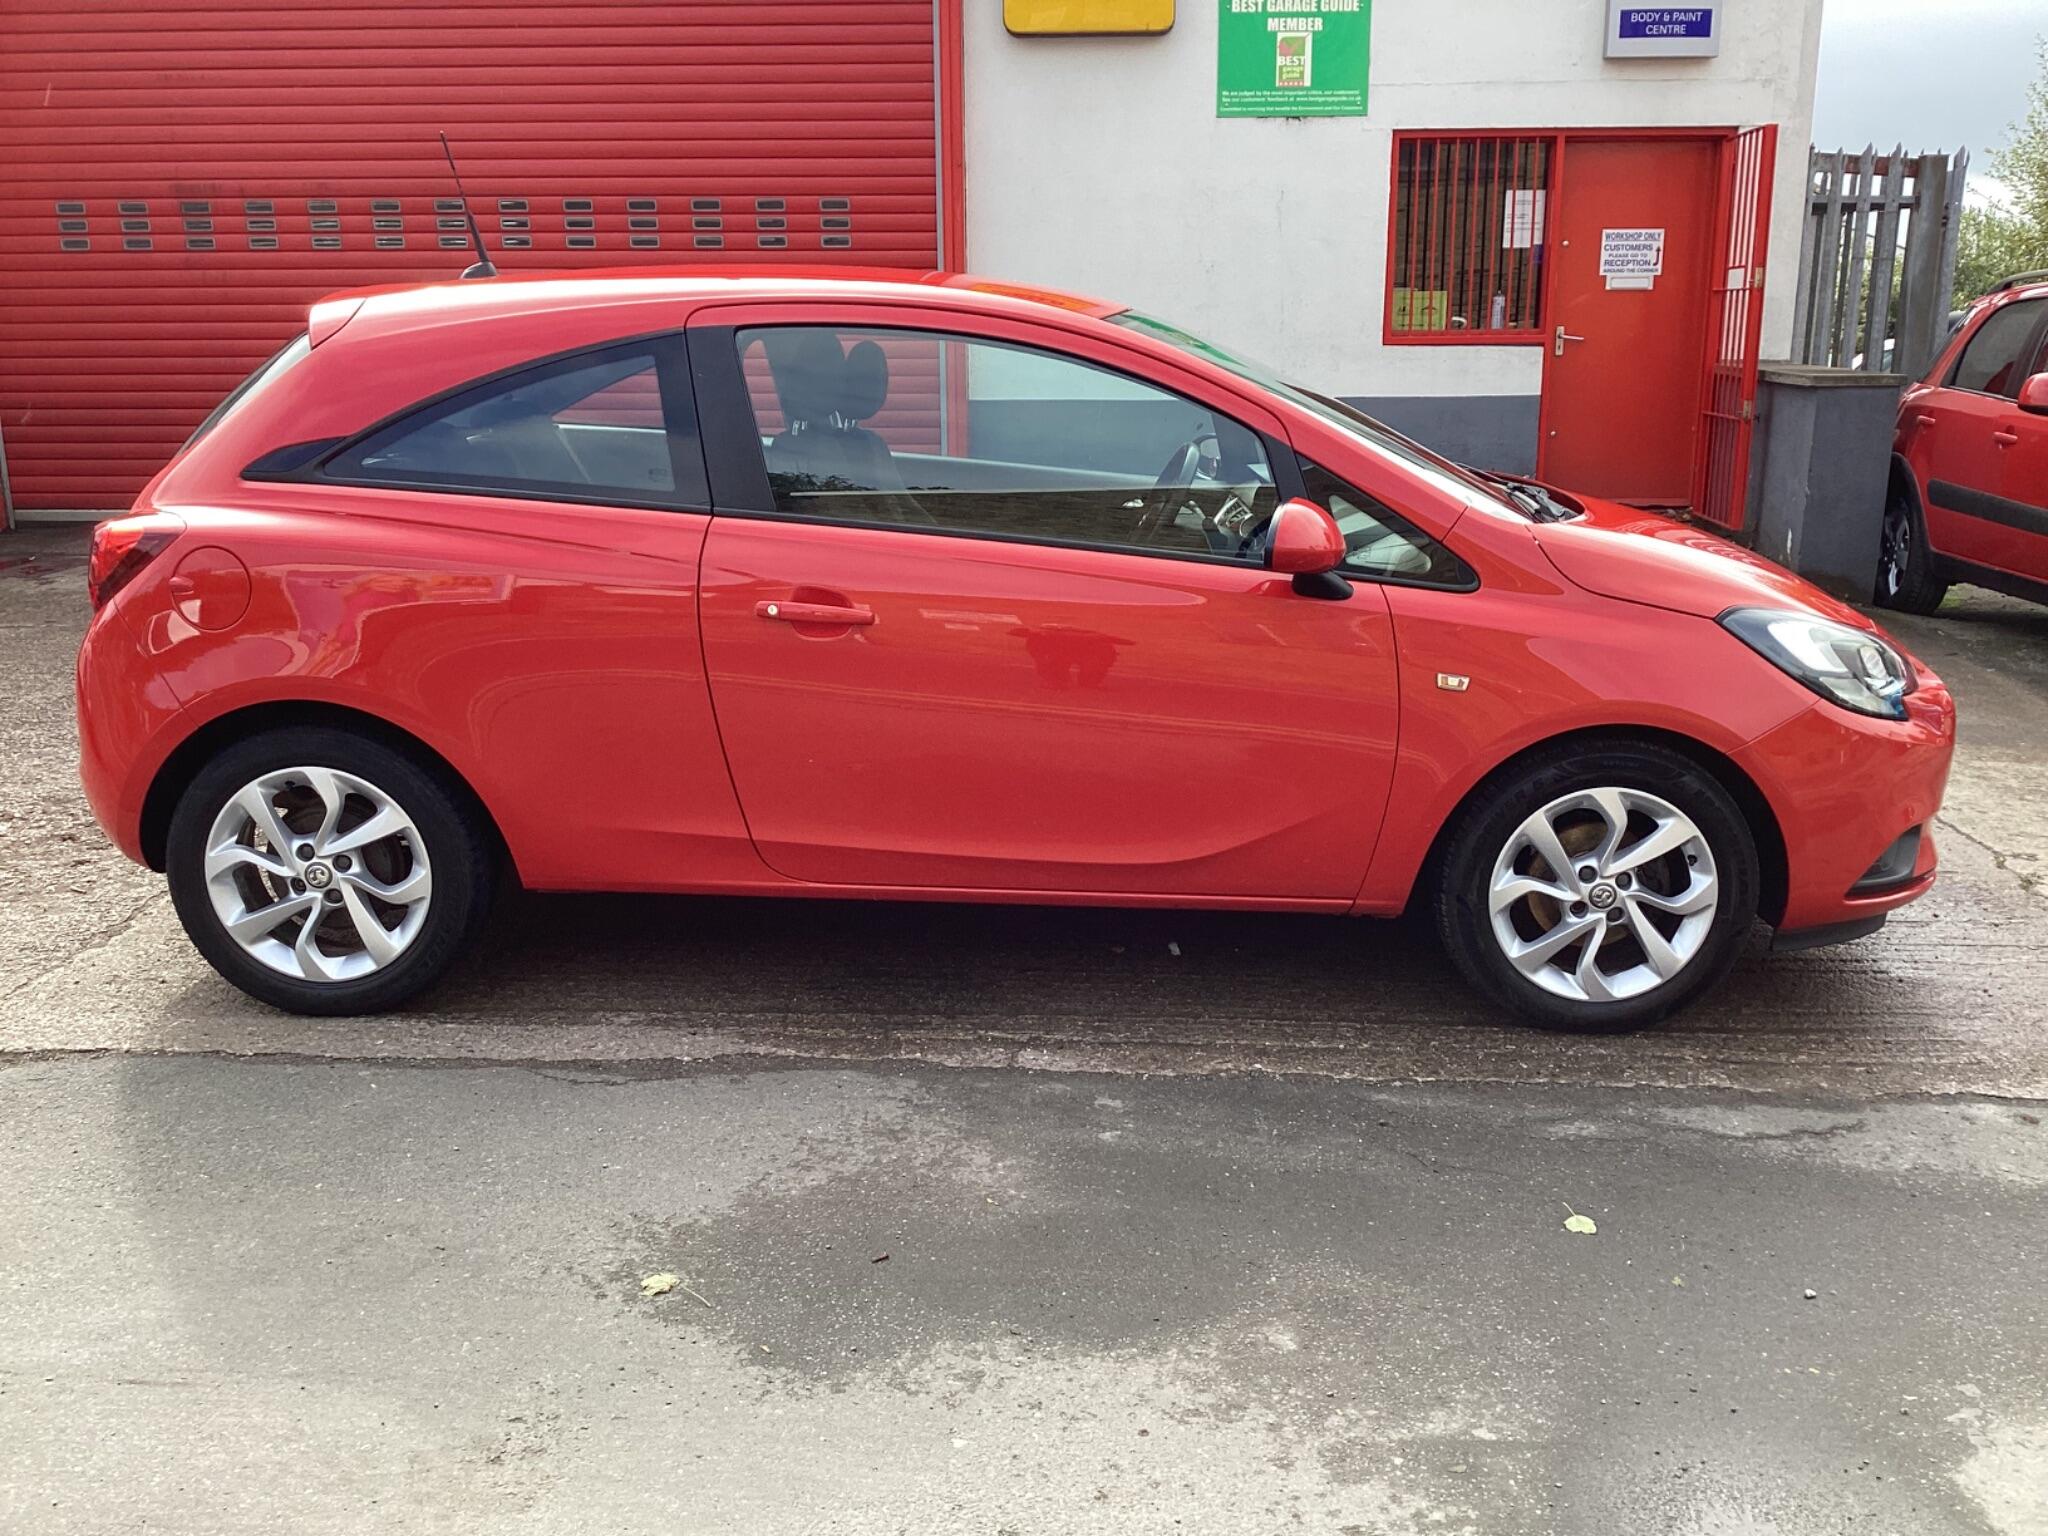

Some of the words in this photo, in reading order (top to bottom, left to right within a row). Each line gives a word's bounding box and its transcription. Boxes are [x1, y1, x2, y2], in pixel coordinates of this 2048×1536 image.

[1231, 0, 1264, 13] BEST
[1267, 0, 1318, 12] GARAGE
[1321, 0, 1360, 12] GUIDE
[1631, 12, 1660, 22] BODY
[1663, 12, 1670, 21] &
[1673, 12, 1703, 22] PAINT
[1267, 17, 1323, 32] MEMBER
[1645, 24, 1687, 35] CENTRE
[1278, 55, 1306, 66] BEST
[1605, 232, 1643, 241] WORKSHOP
[1644, 232, 1661, 240] ONLY
[1604, 259, 1651, 267] RECEPTION
